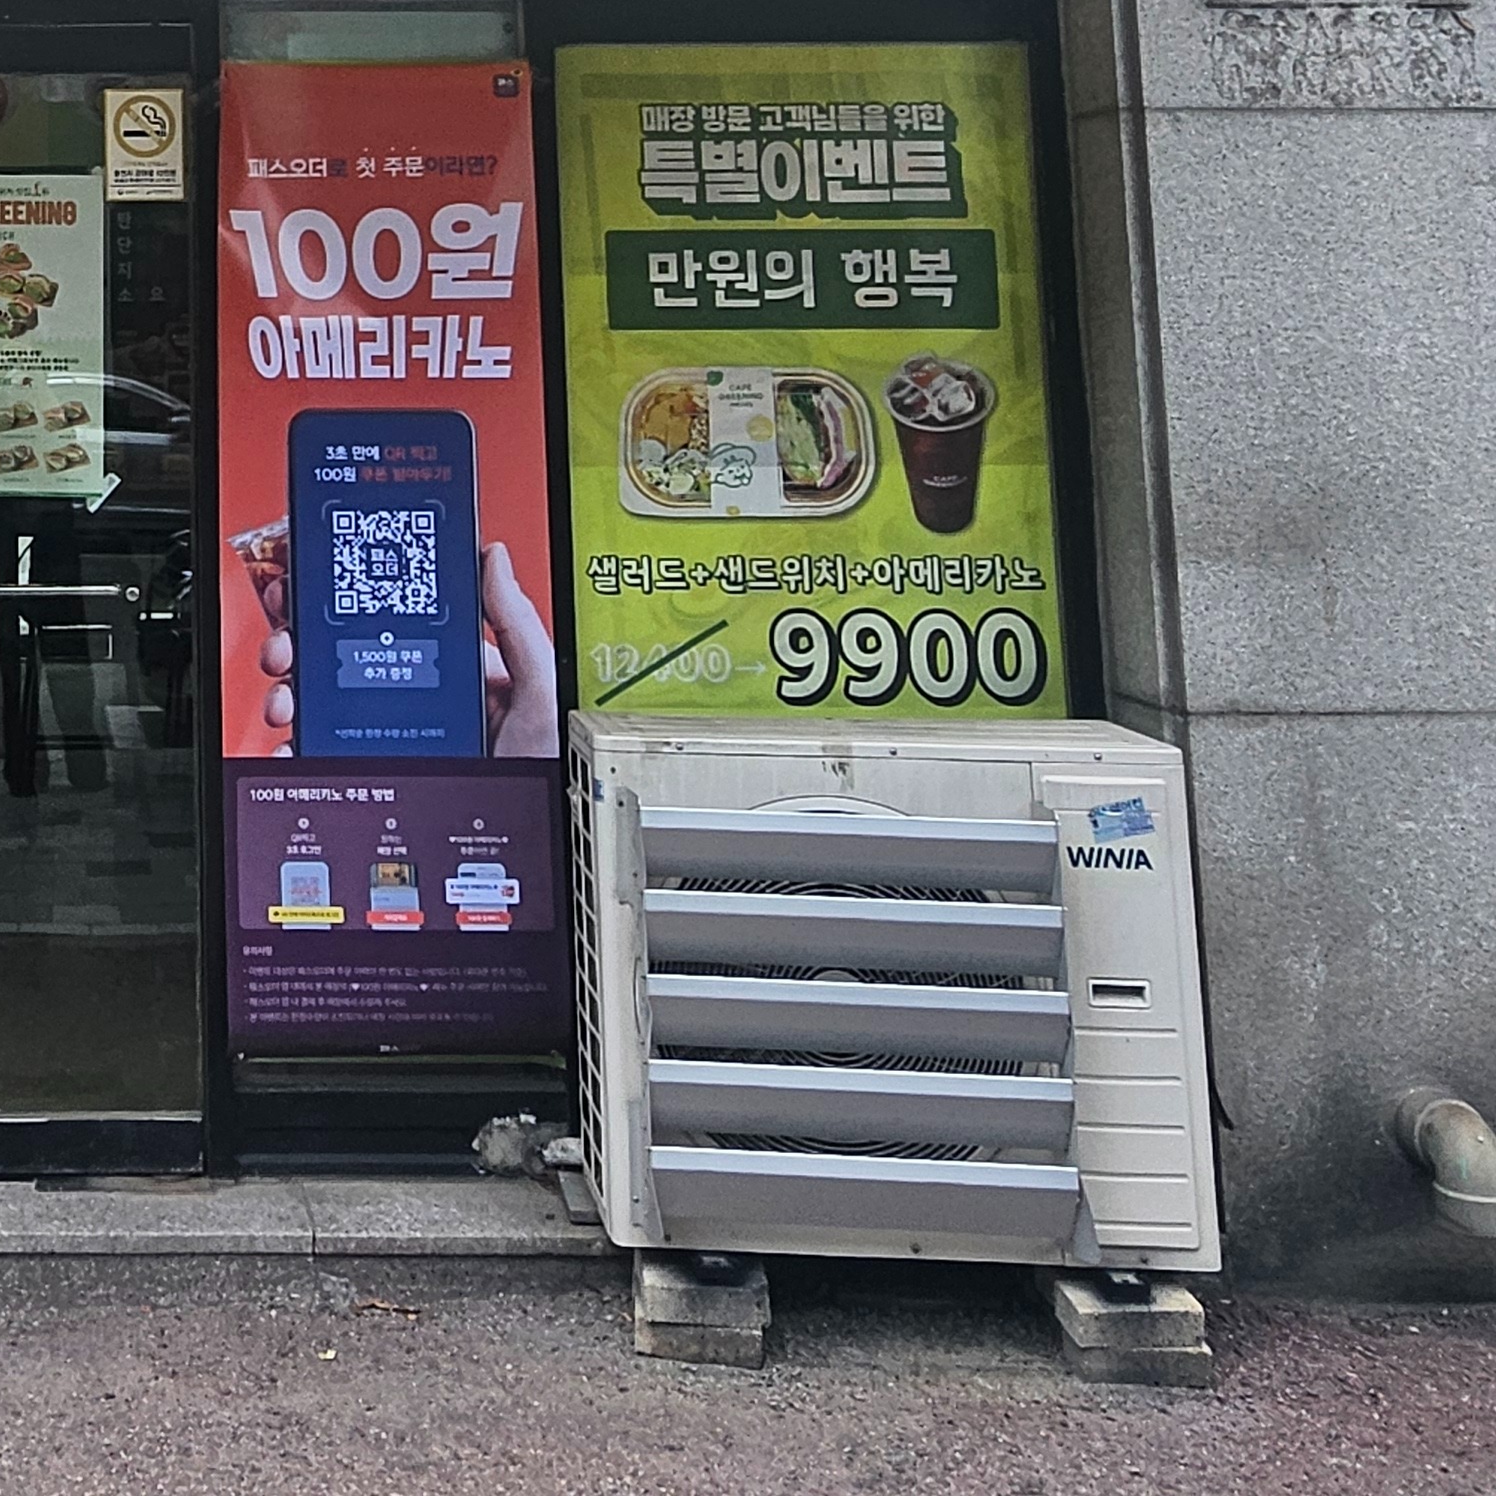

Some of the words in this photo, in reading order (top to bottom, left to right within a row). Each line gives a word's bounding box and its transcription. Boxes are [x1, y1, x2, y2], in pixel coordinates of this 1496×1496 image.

[641, 104, 696, 133] 매장
[701, 104, 752, 133] 방문
[758, 104, 887, 132] 고객님들을
[893, 103, 946, 132] 위한
[356, 156, 377, 178] 첫
[640, 138, 951, 204] 특별이벤트
[229, 202, 524, 301] 100원
[648, 248, 816, 309] 만원의
[840, 248, 958, 309] 행복
[248, 315, 512, 379] 아메리카노
[314, 466, 357, 482] 100원
[588, 555, 1045, 594] 샐러드+샌드위치+아메리카노
[771, 609, 1045, 704] 9900
[1066, 845, 1154, 871] WINIA
